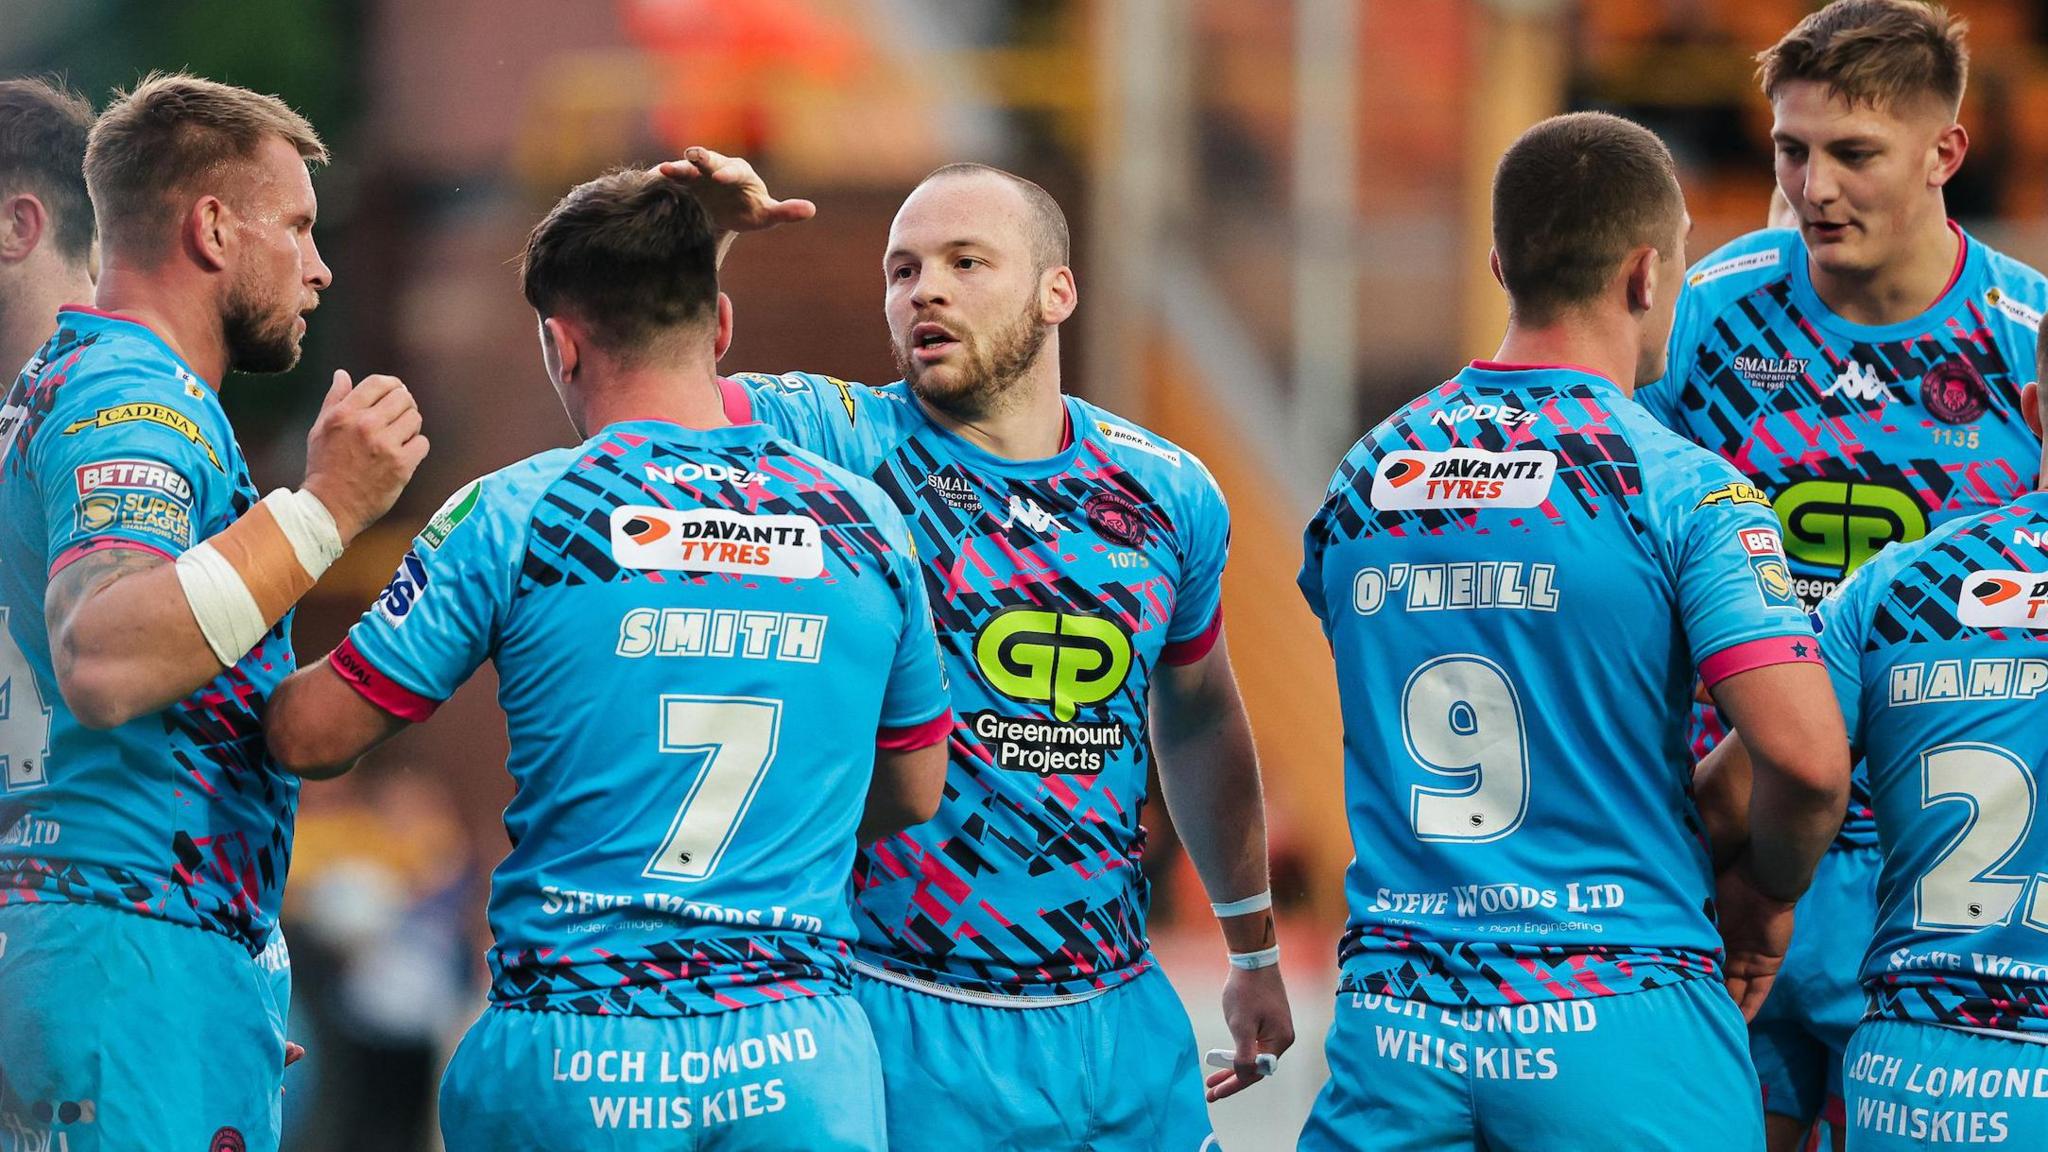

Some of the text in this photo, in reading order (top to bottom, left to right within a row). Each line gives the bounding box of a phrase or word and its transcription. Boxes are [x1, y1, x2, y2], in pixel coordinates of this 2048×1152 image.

[1734, 357, 1808, 374] SMALLEY
[1744, 371, 1796, 381] Decorators
[105, 403, 192, 433] CADENA
[1430, 404, 1539, 427] NODE4
[1114, 431, 1143, 445] BROKK
[1932, 428, 1979, 449] 1135
[82, 464, 192, 499] BETFRED
[1429, 458, 1543, 480] DAVANTI
[1426, 480, 1504, 500] TYRES
[123, 493, 189, 527] SUPER
[122, 511, 189, 540] LEAGUE
[682, 520, 805, 547] DAVANTI
[681, 541, 770, 566] TYRES
[1107, 552, 1149, 569] 1075
[1353, 561, 1560, 616] O'NEILL
[615, 607, 828, 664] SMITH
[976, 714, 1121, 746] Greenmount
[1001, 742, 1101, 773] Projects
[1401, 653, 1530, 844] 9
[641, 694, 783, 883] 7
[541, 886, 632, 914] STEVE
[1368, 883, 1625, 917] STEVE WOODS LTD
[1524, 921, 1603, 935] Engineering
[1440, 1001, 1597, 1034] LOMOND
[553, 1028, 818, 1084] LOCH LOMOND
[1376, 1025, 1558, 1080] WHISKIES
[589, 1079, 786, 1129] WHISKIES
[1857, 1096, 2009, 1143] WHISKIES
